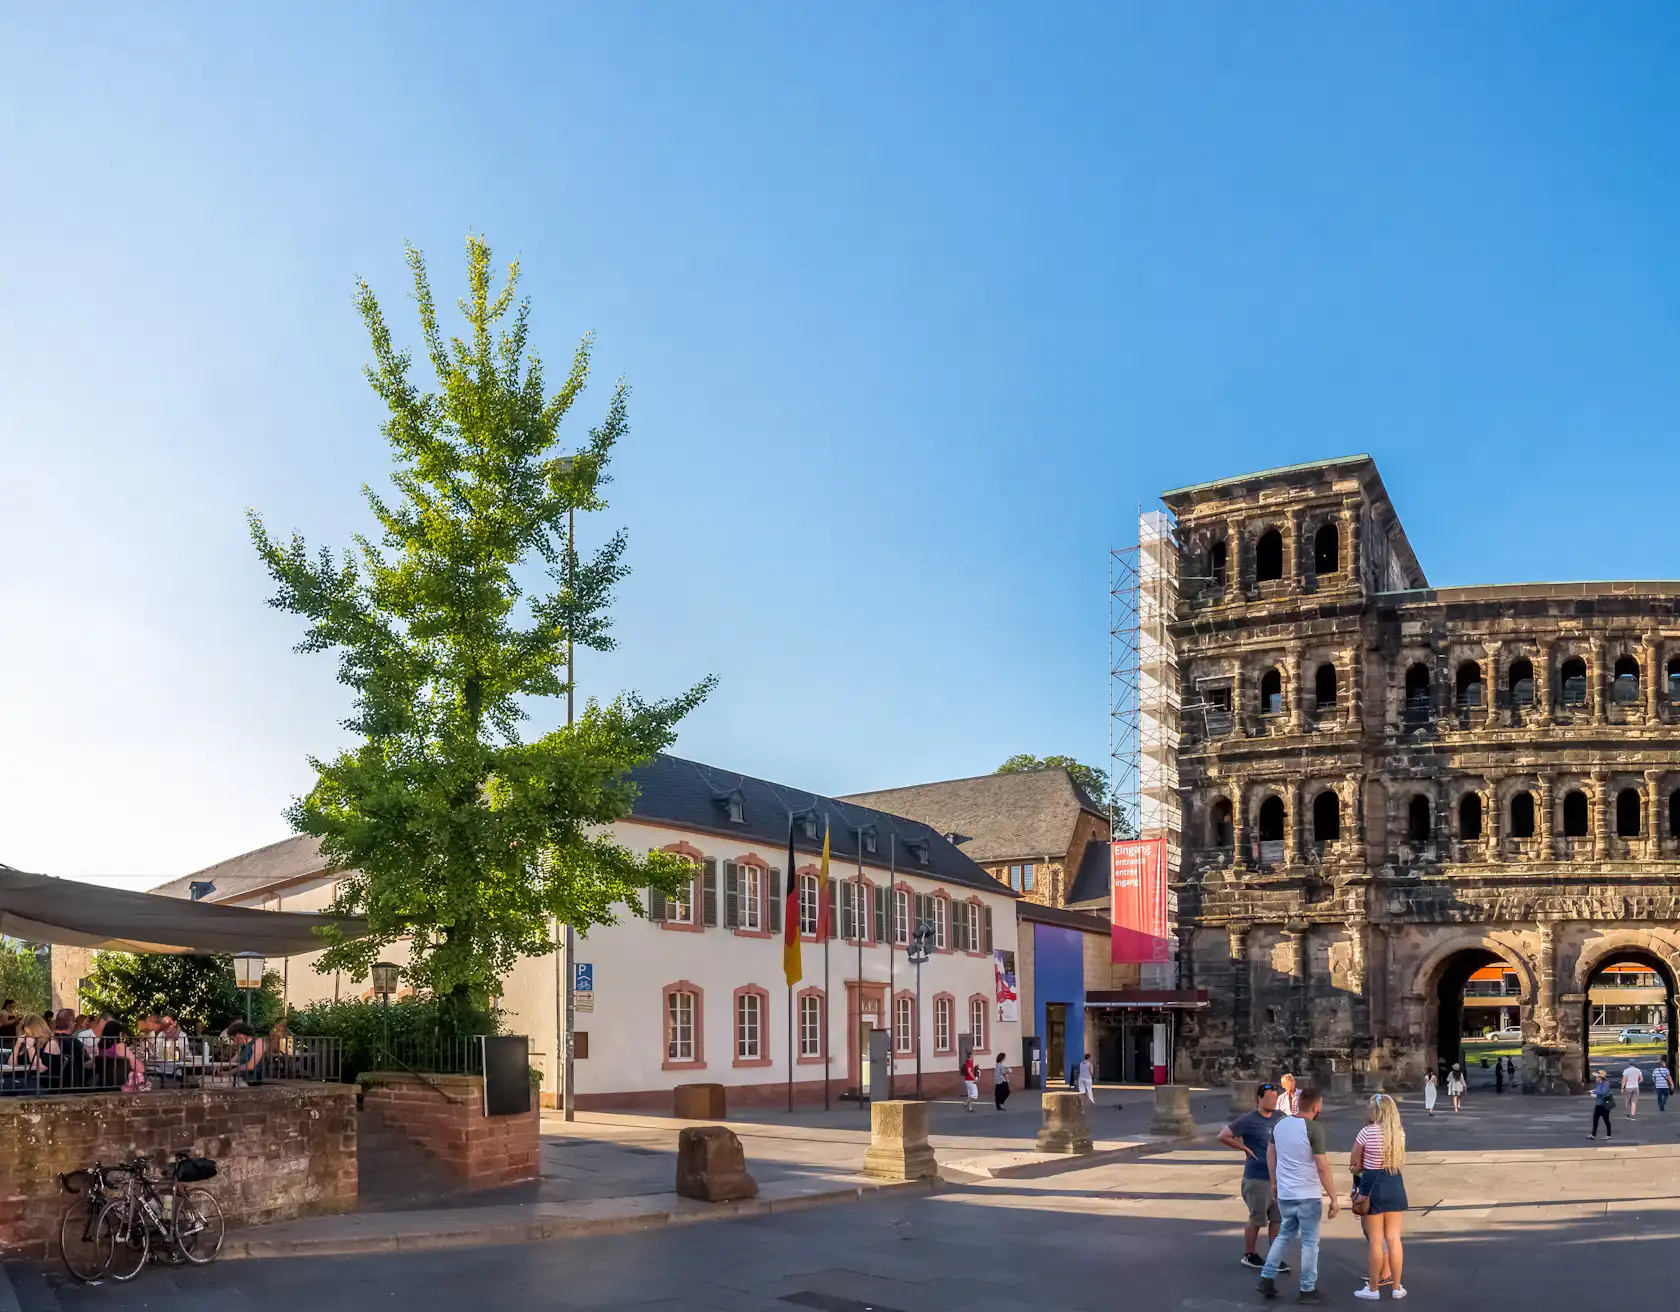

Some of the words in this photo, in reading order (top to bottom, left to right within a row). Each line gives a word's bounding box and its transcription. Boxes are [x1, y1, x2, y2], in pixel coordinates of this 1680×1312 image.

[1114, 845, 1151, 856] Eingang
[1115, 867, 1138, 876] entrée
[1115, 878, 1139, 887] ingang
[578, 964, 586, 975] P
